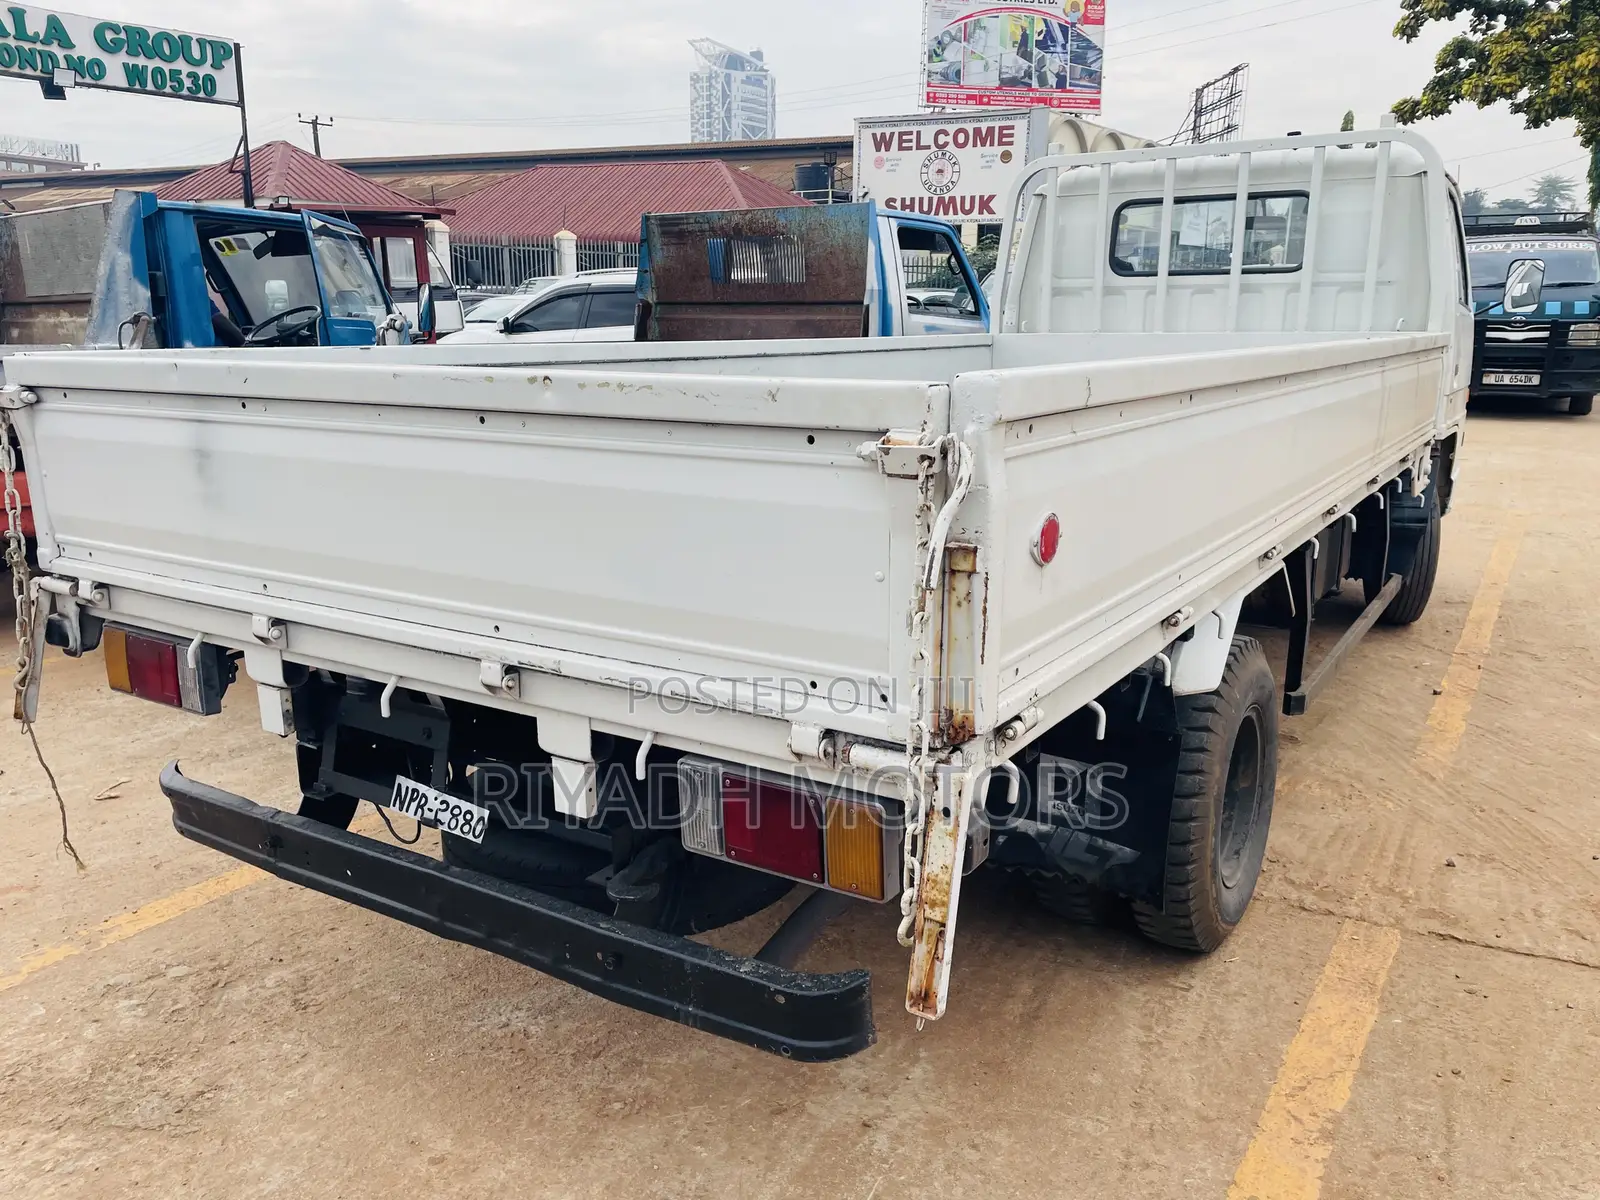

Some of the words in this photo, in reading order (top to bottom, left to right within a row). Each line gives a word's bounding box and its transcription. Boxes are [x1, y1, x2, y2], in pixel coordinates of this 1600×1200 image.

[94, 22, 233, 70] GROUP
[64, 54, 107, 81] NO
[122, 62, 217, 97] W0530
[871, 125, 1015, 152] WELCOME
[923, 151, 959, 169] SHUMUK
[923, 179, 956, 194] UGANDA
[1511, 241, 1542, 250] BUT
[1494, 374, 1504, 383] UA
